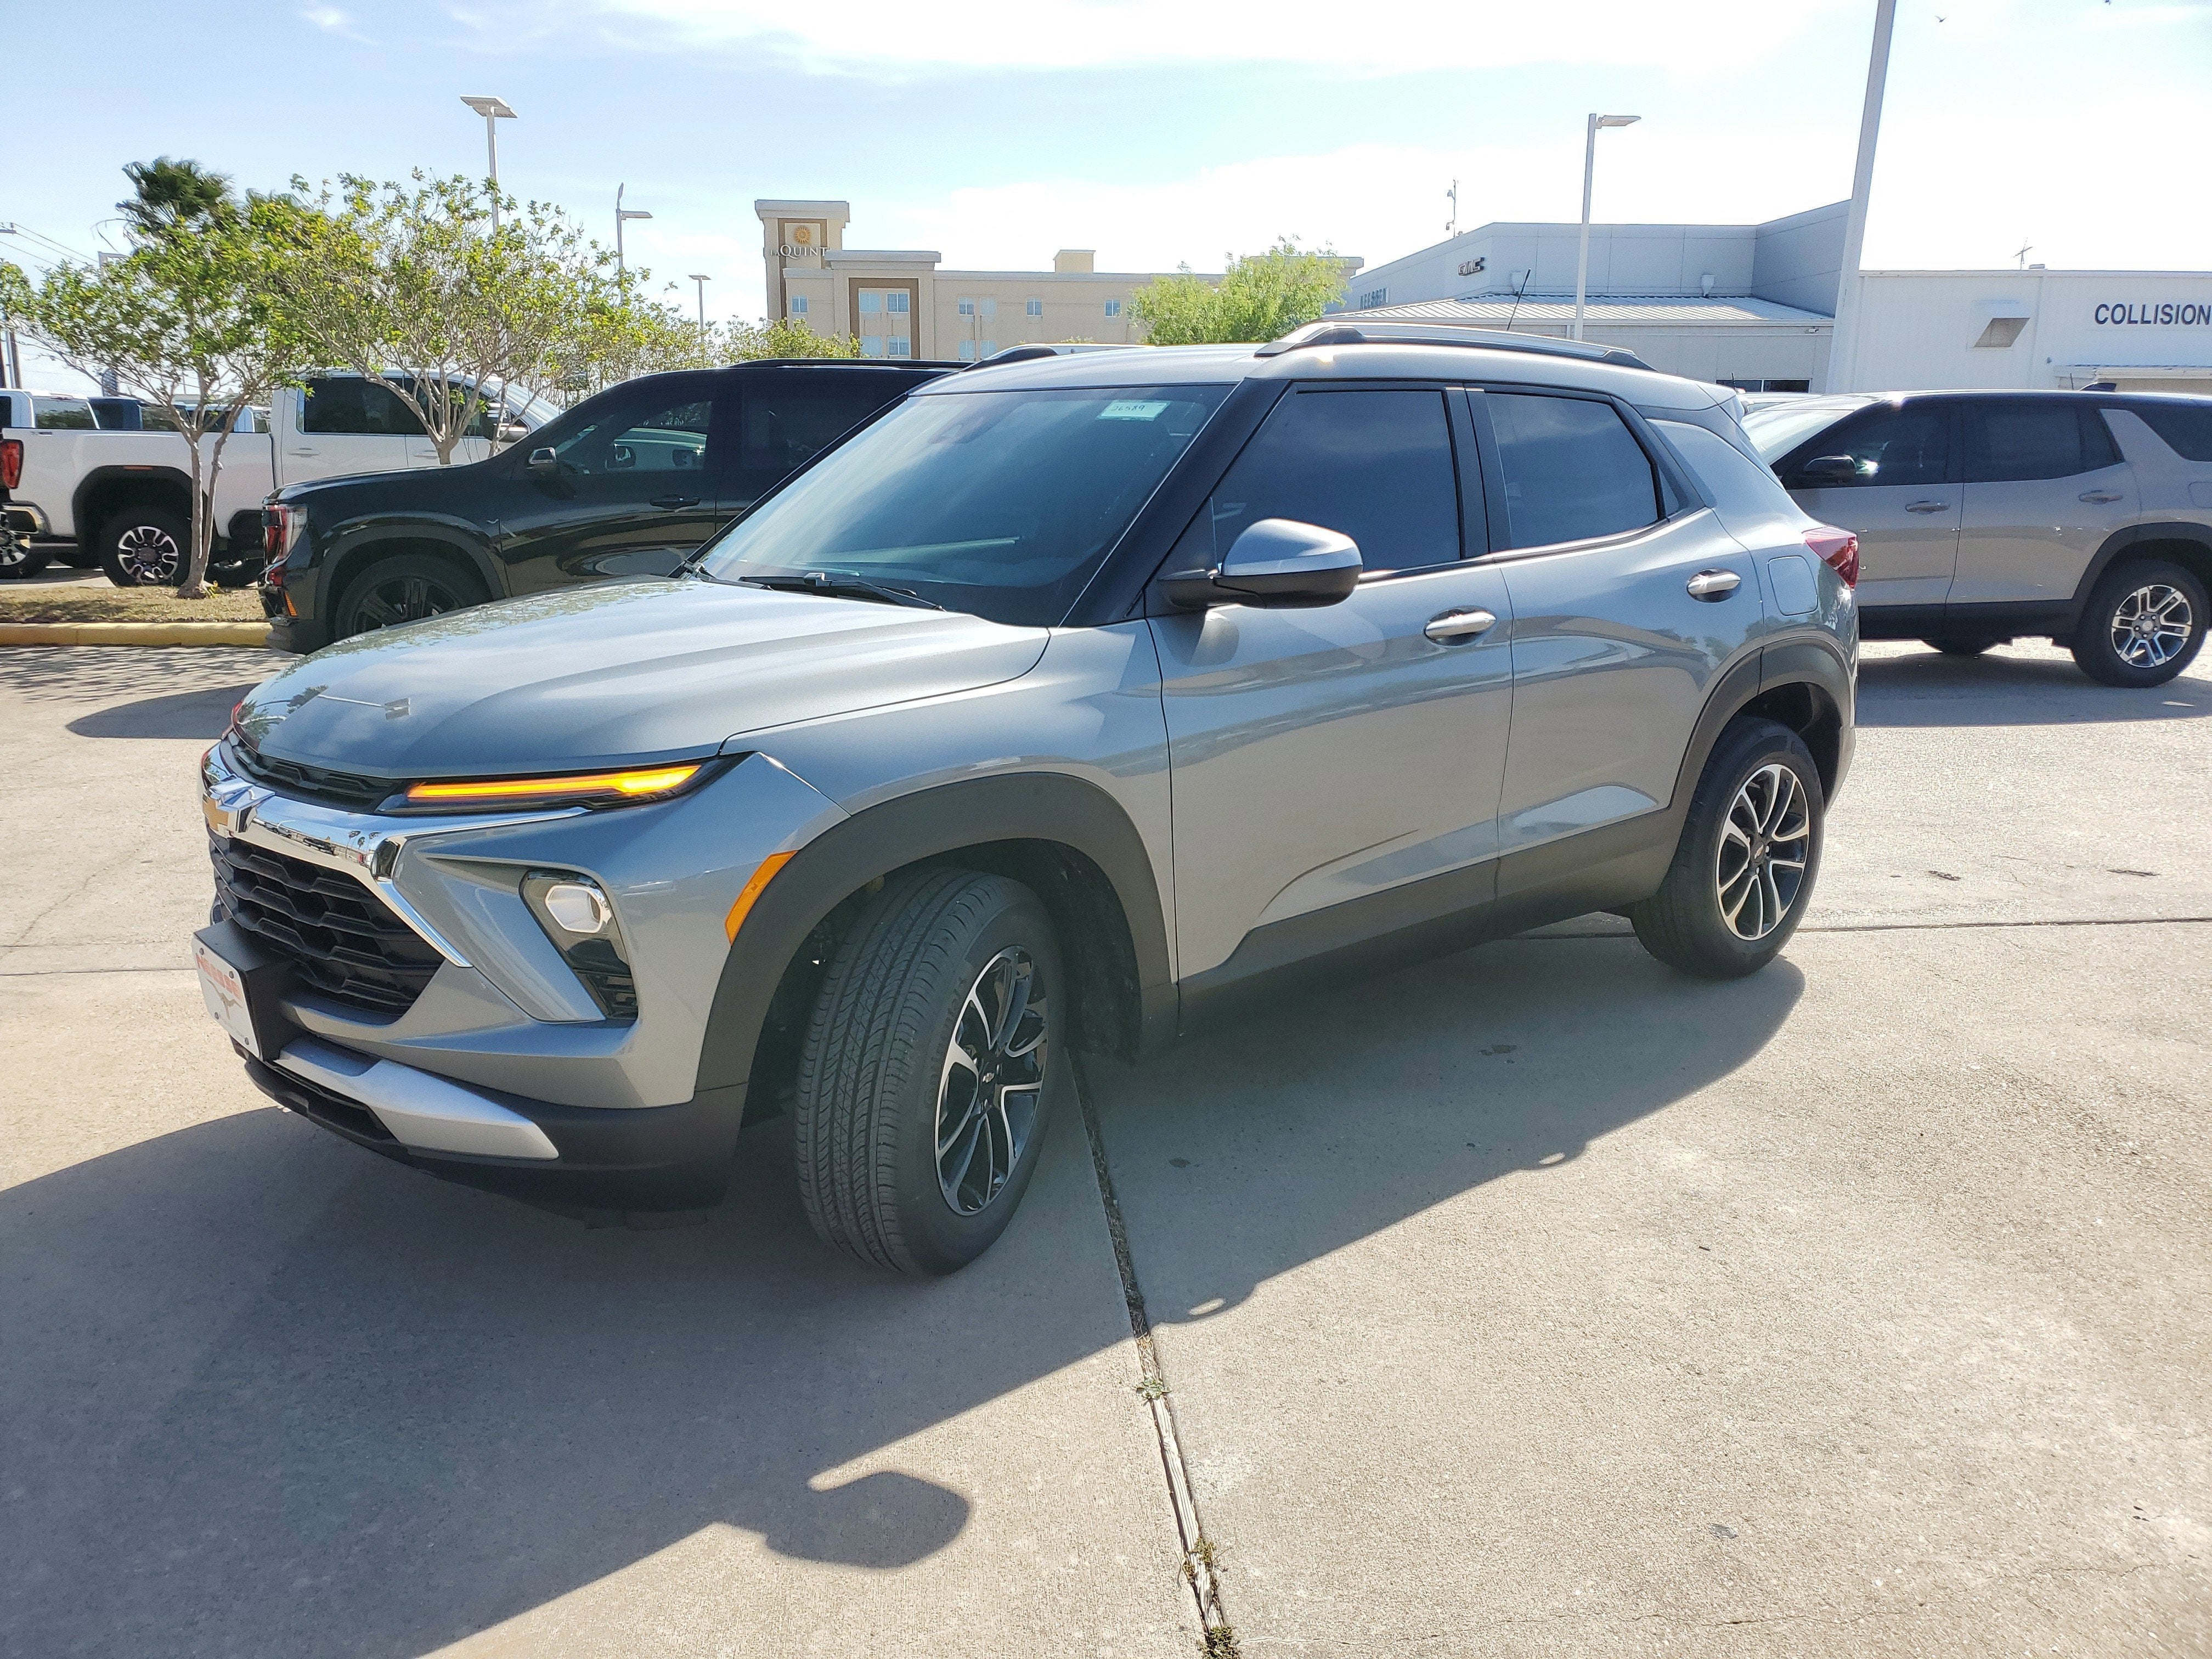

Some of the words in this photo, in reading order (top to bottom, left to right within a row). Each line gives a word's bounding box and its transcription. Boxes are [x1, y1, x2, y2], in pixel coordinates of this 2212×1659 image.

[780, 244, 832, 259] QUINT
[1458, 257, 1485, 276] GMC
[2095, 303, 2212, 325] COLLISION
